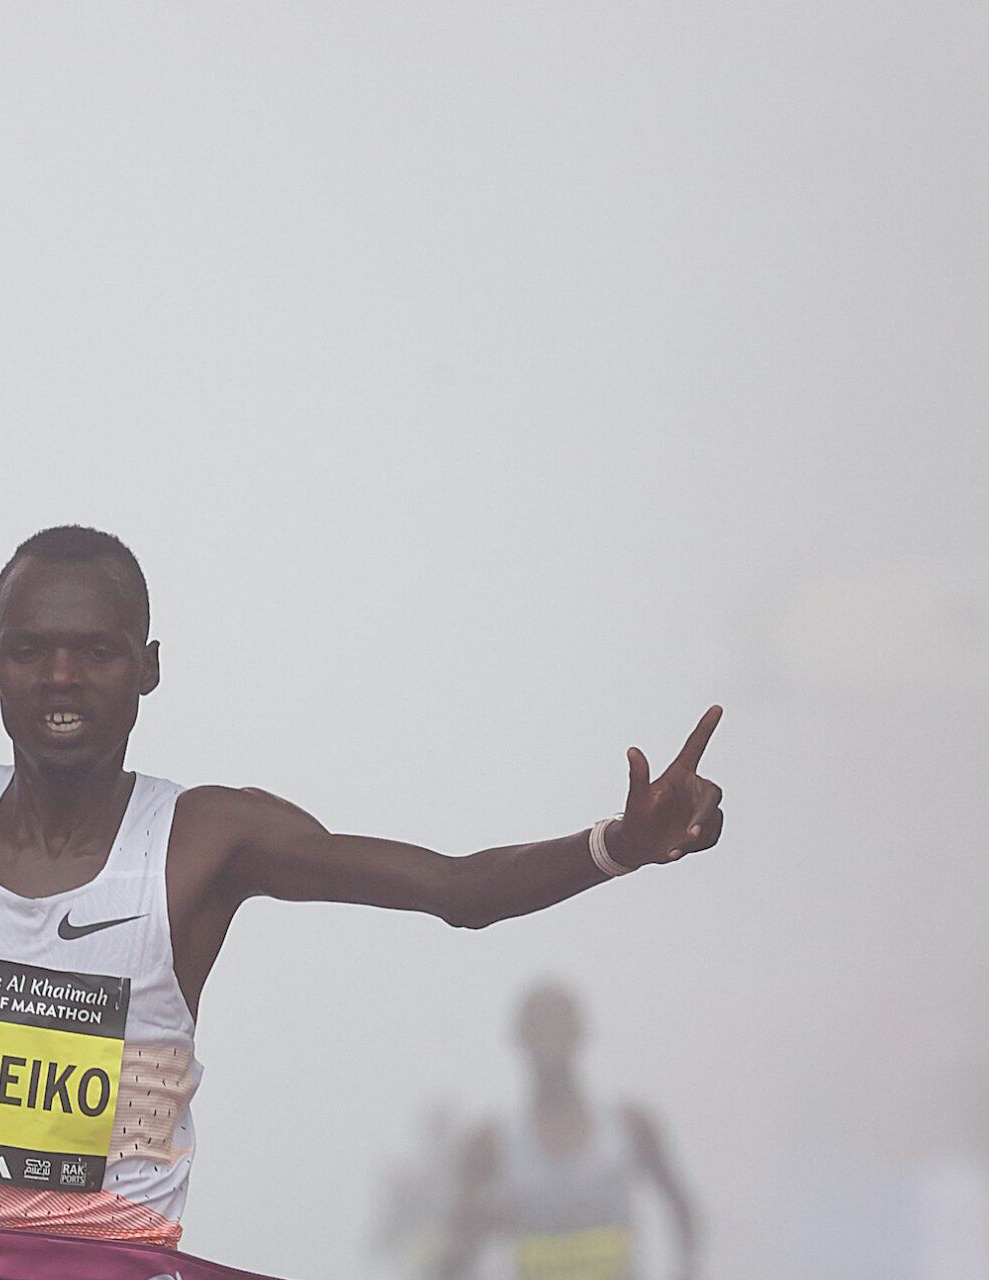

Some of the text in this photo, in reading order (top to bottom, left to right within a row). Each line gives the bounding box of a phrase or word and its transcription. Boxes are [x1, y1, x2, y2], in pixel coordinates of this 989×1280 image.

[6, 974, 26, 993] Al
[30, 978, 108, 1006] Khaimah
[11, 998, 102, 1024] MARATHON
[63, 1164, 85, 1176] RAK
[62, 1175, 86, 1185] PORTS
